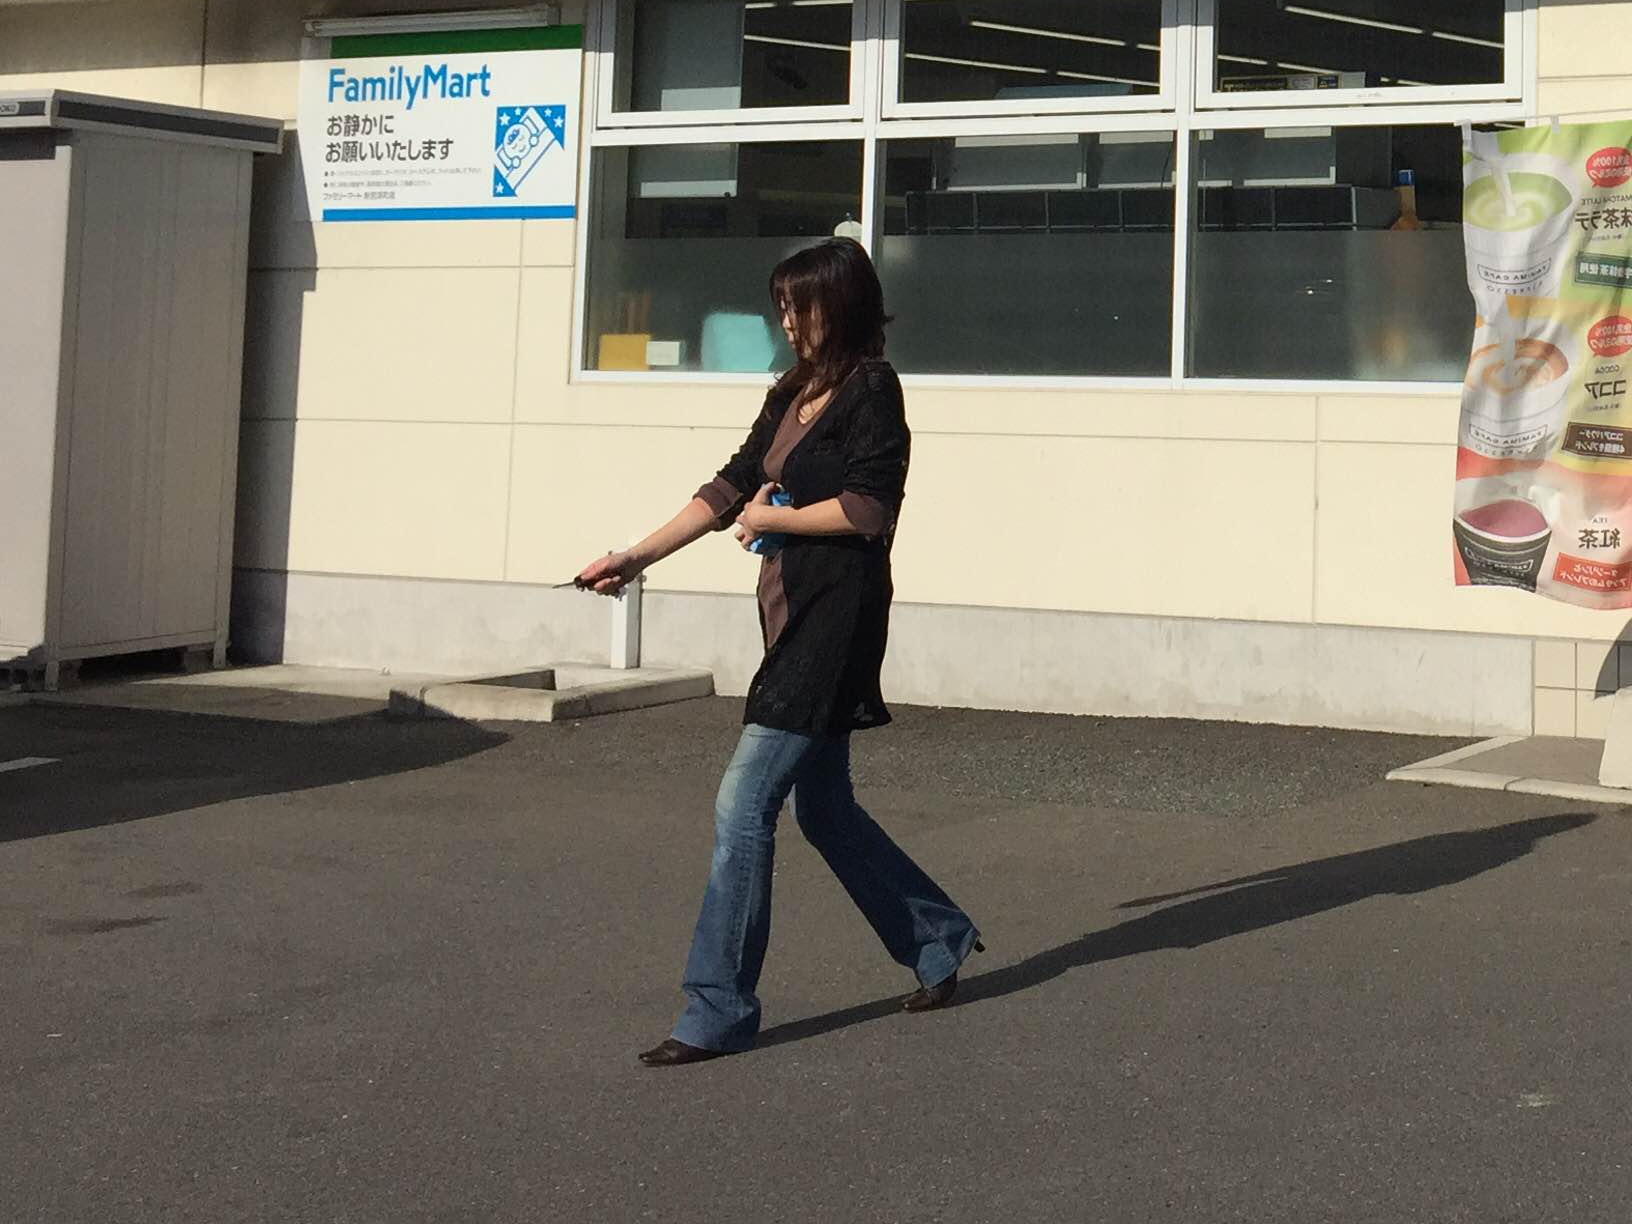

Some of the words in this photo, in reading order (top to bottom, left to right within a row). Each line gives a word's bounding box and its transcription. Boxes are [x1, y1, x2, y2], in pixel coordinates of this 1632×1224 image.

[328, 64, 491, 110] FamilyMart
[327, 114, 394, 136] お静かに
[325, 139, 453, 163] お願いいたします
